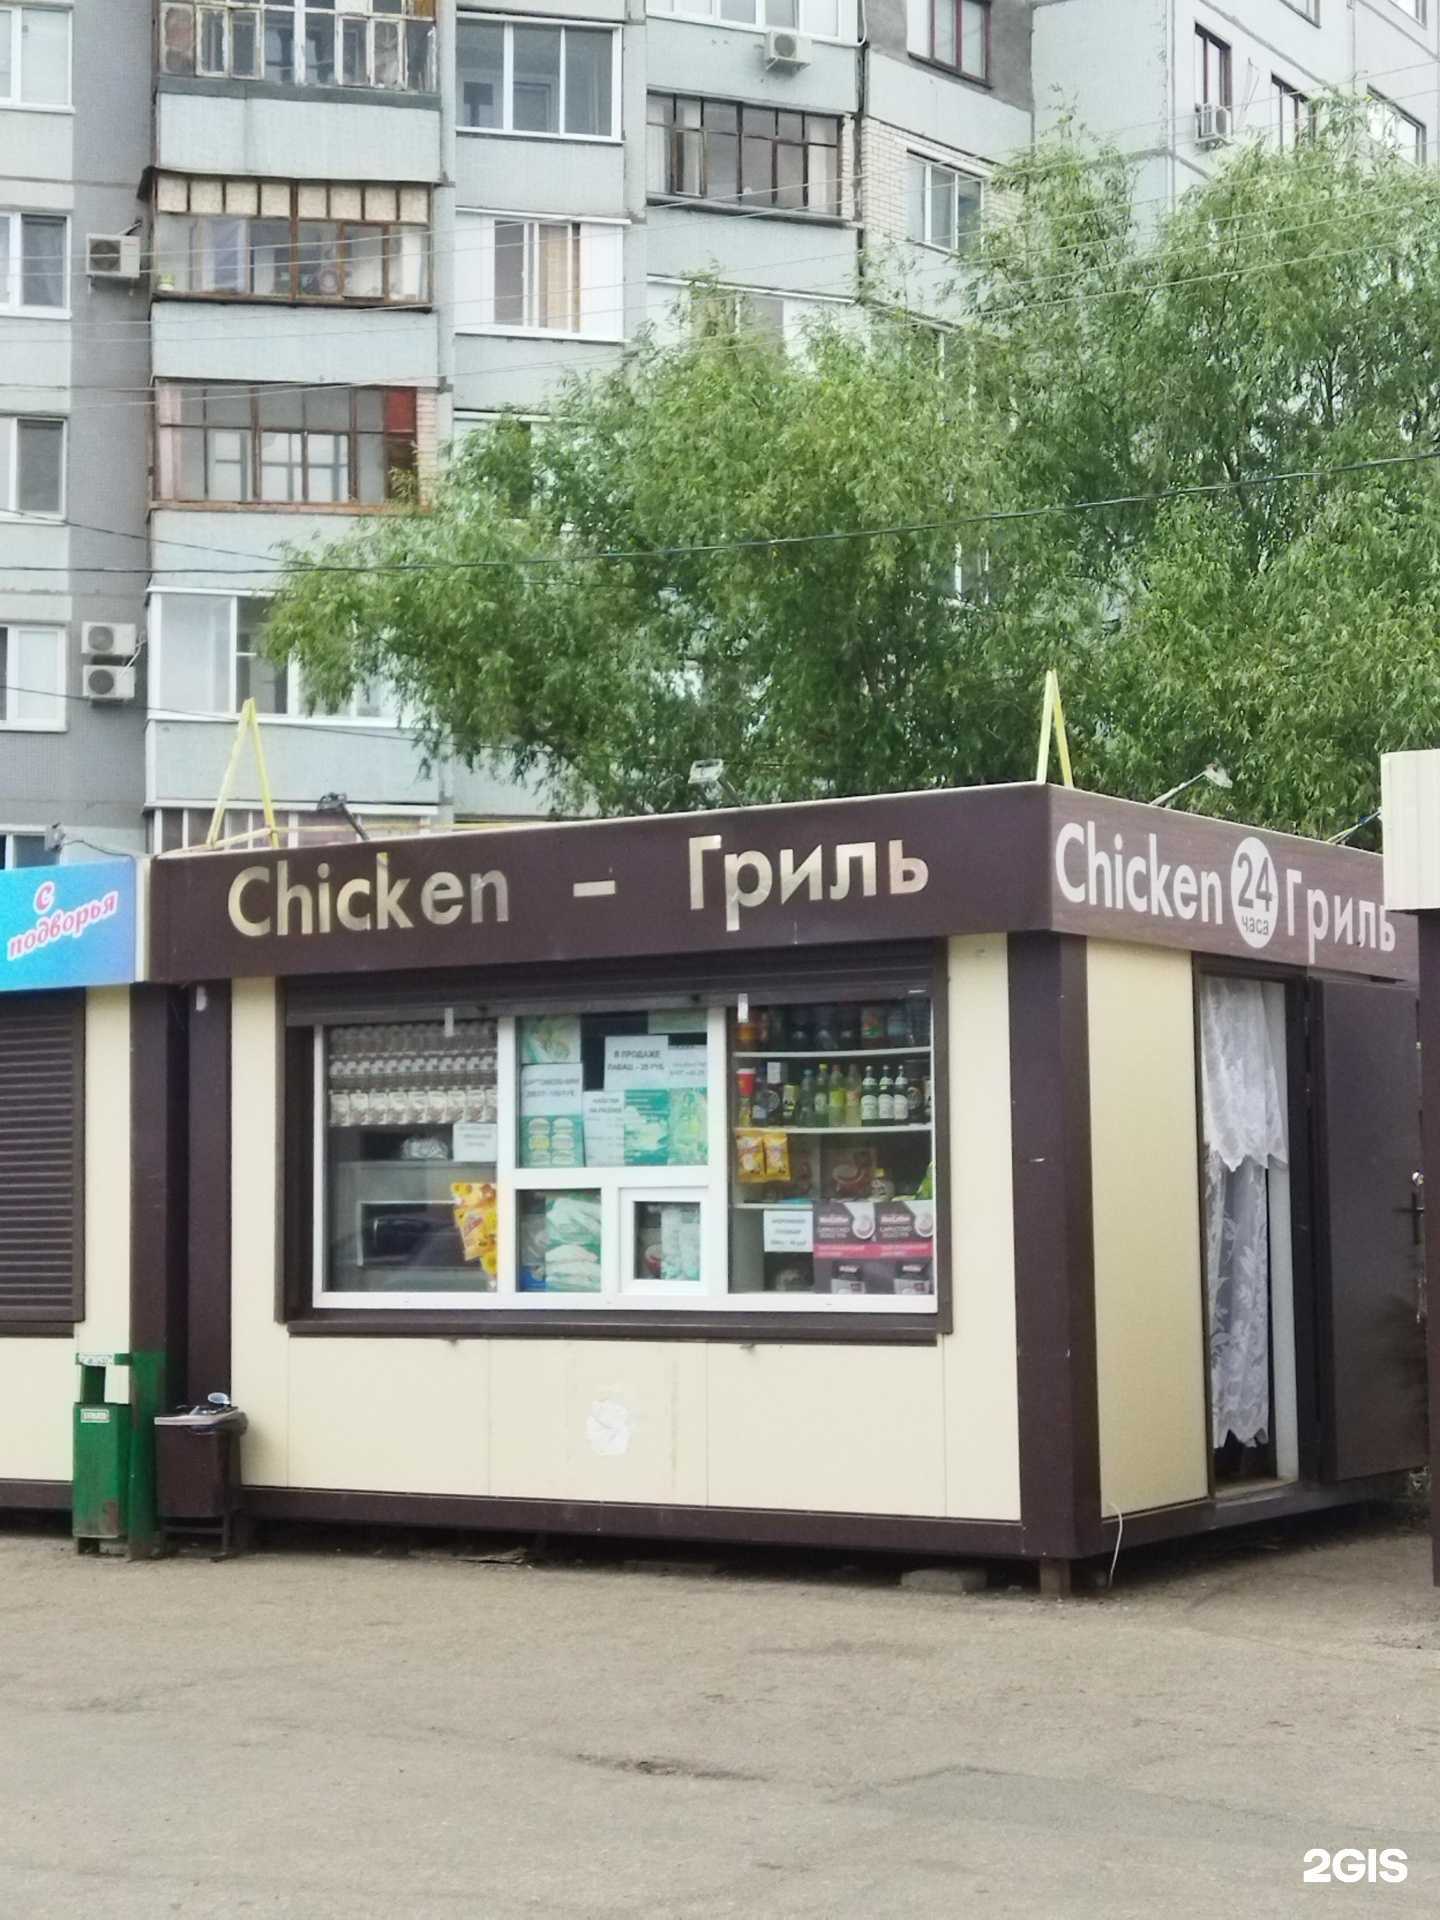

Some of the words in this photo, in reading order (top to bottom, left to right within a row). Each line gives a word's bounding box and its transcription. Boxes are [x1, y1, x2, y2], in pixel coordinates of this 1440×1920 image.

[6, 890, 119, 961] подворья
[227, 851, 509, 937] Chicken
[688, 834, 929, 932] Гриль
[1054, 820, 1224, 925] Chicken
[1237, 851, 1273, 912] 24
[1285, 868, 1396, 964] Гриль
[1241, 915, 1270, 936] часа
